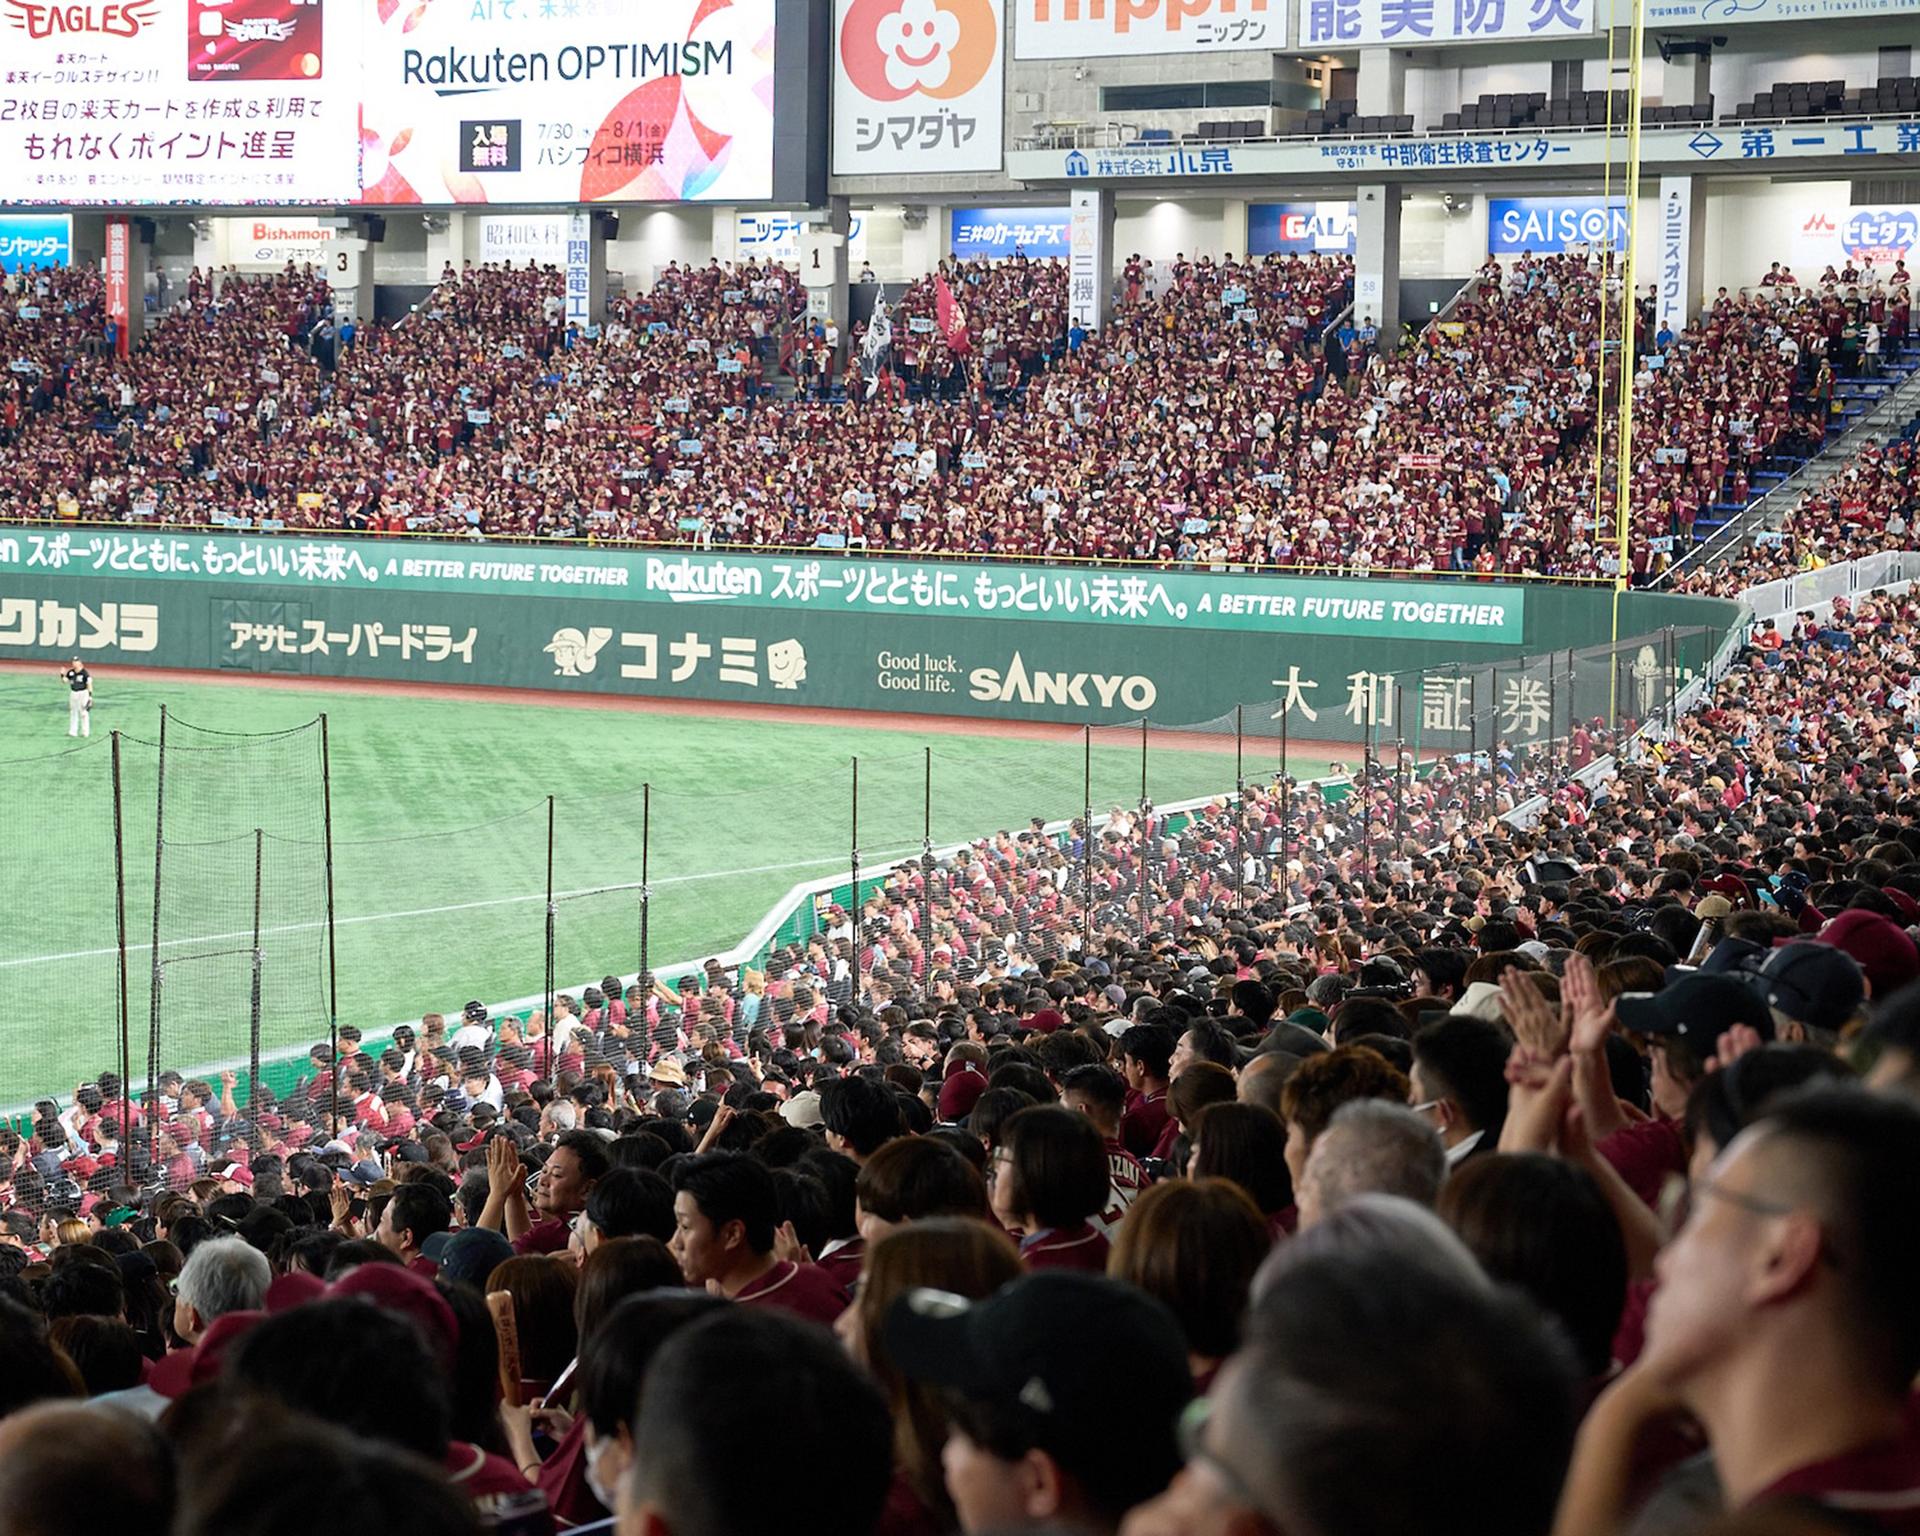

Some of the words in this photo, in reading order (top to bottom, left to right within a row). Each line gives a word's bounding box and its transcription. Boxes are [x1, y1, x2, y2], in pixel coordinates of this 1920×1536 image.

[26, 4, 139, 39] EAGLES
[1777, 3, 1815, 14] Space
[1197, 19, 1266, 42] ニップン
[404, 47, 548, 84] Rakuten
[557, 40, 733, 79] OPTIMISM
[856, 108, 976, 152] シマダヤ
[1321, 145, 1377, 156] 食品の安全を
[1381, 139, 1570, 167] 中部衛生検査センター
[1096, 157, 1163, 175] 株式会社
[253, 223, 331, 241] Bishamon
[957, 222, 1067, 245] 三井のカーシェアーズ
[1502, 208, 1633, 243] SAISON
[1842, 221, 1917, 246] ビヒダス
[337, 252, 348, 272] 3
[812, 247, 820, 269] 1
[1664, 202, 1682, 318] シミズオクト
[567, 240, 588, 318] 関電工
[1362, 280, 1377, 292] 58
[26, 533, 379, 582] スポーツとともに、もっといい未来へ。
[385, 558, 398, 576] A
[402, 559, 465, 579] BETTER
[469, 562, 535, 582] FUTURE
[539, 563, 629, 586] TOGETHER
[646, 558, 762, 597] Rakuten
[770, 562, 1188, 620] スポーツとともに、もっといい未来へ。
[1197, 593, 1212, 613] A
[1218, 593, 1296, 617] BETTER
[1302, 597, 1385, 621] FUTURE
[1392, 600, 1505, 626] TOGETHER
[229, 618, 478, 664] アサヒスーパードライ
[621, 632, 759, 687] コナミ
[878, 651, 921, 672] Good
[924, 653, 964, 674] luck.
[878, 669, 921, 692] Good
[924, 672, 956, 693] life.
[969, 649, 1158, 712] SANKYO
[1270, 664, 1552, 738] 大和証券
